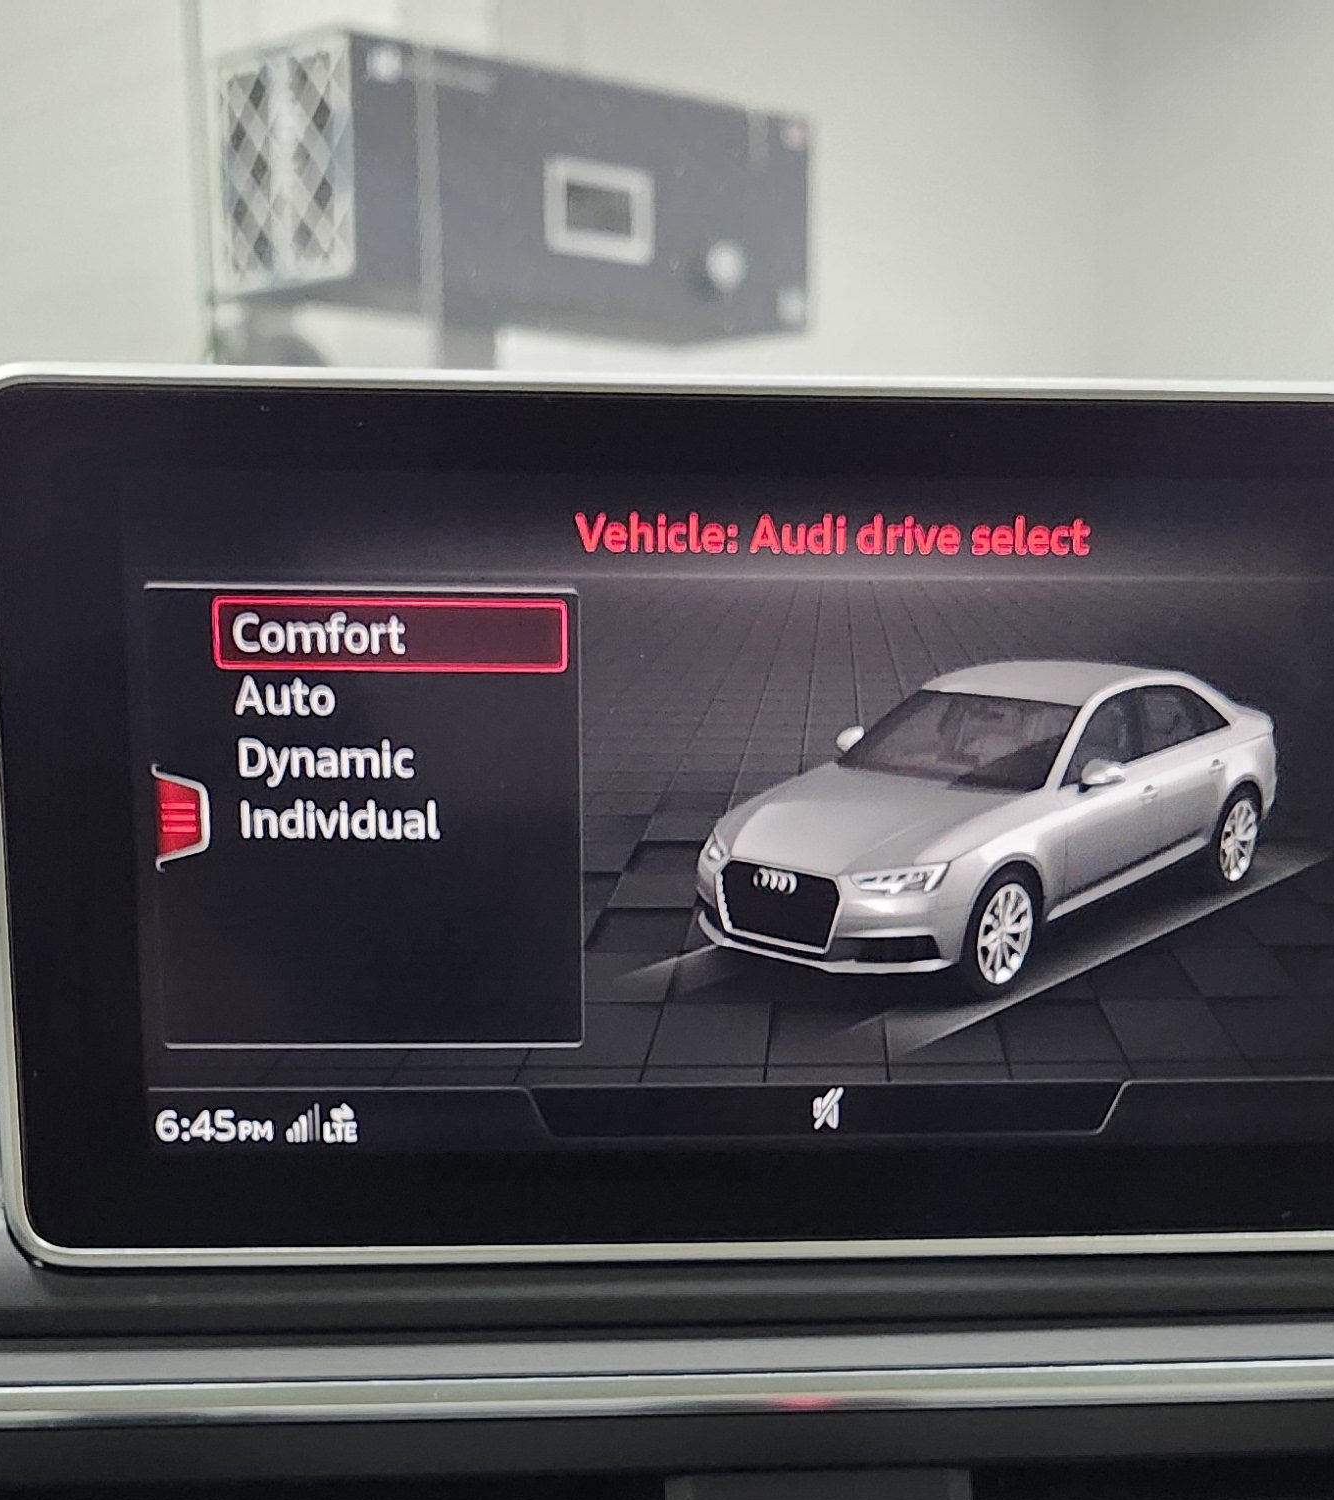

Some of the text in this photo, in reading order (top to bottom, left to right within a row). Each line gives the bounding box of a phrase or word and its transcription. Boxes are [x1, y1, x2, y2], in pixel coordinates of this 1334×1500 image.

[575, 511, 1090, 556] Vehicle: Audi drive select
[231, 612, 407, 656] Comfort
[234, 675, 337, 716] Auto
[237, 737, 416, 788] Dynamic
[239, 799, 442, 841] Individual
[322, 1121, 359, 1142] LTE
